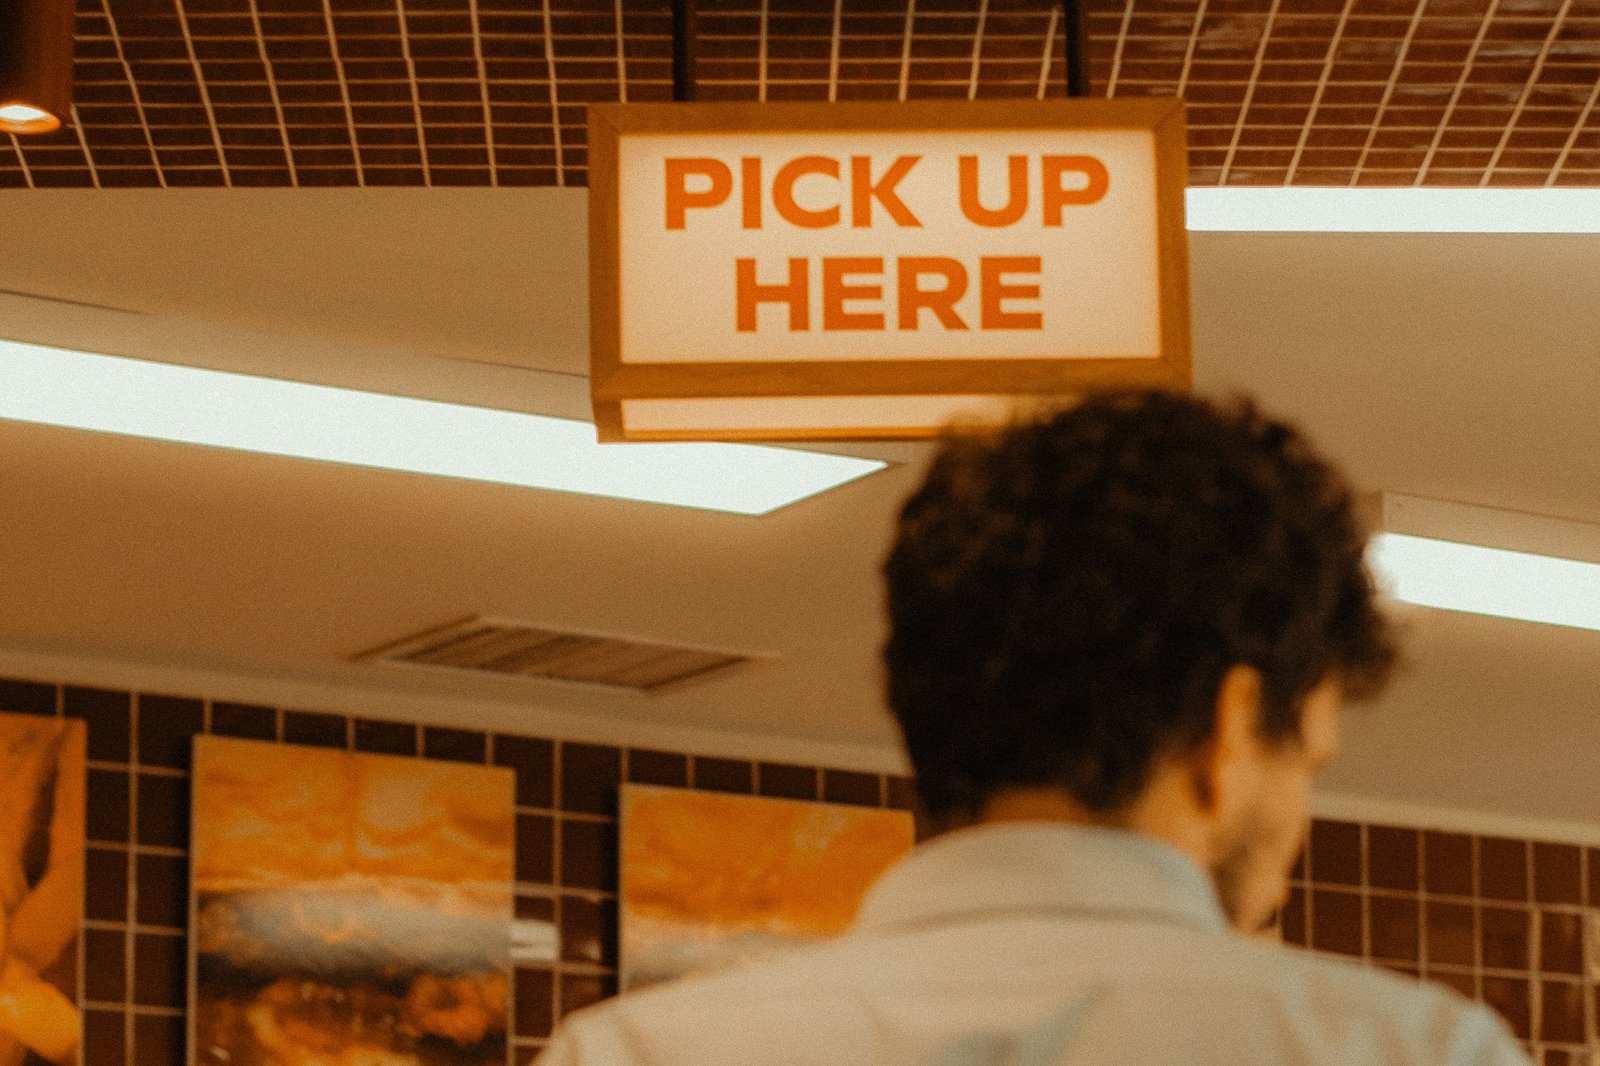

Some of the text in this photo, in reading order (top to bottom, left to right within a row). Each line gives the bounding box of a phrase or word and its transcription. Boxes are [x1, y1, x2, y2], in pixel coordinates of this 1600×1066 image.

[665, 154, 1110, 230] PICK UP
[736, 256, 1044, 332] HERE
